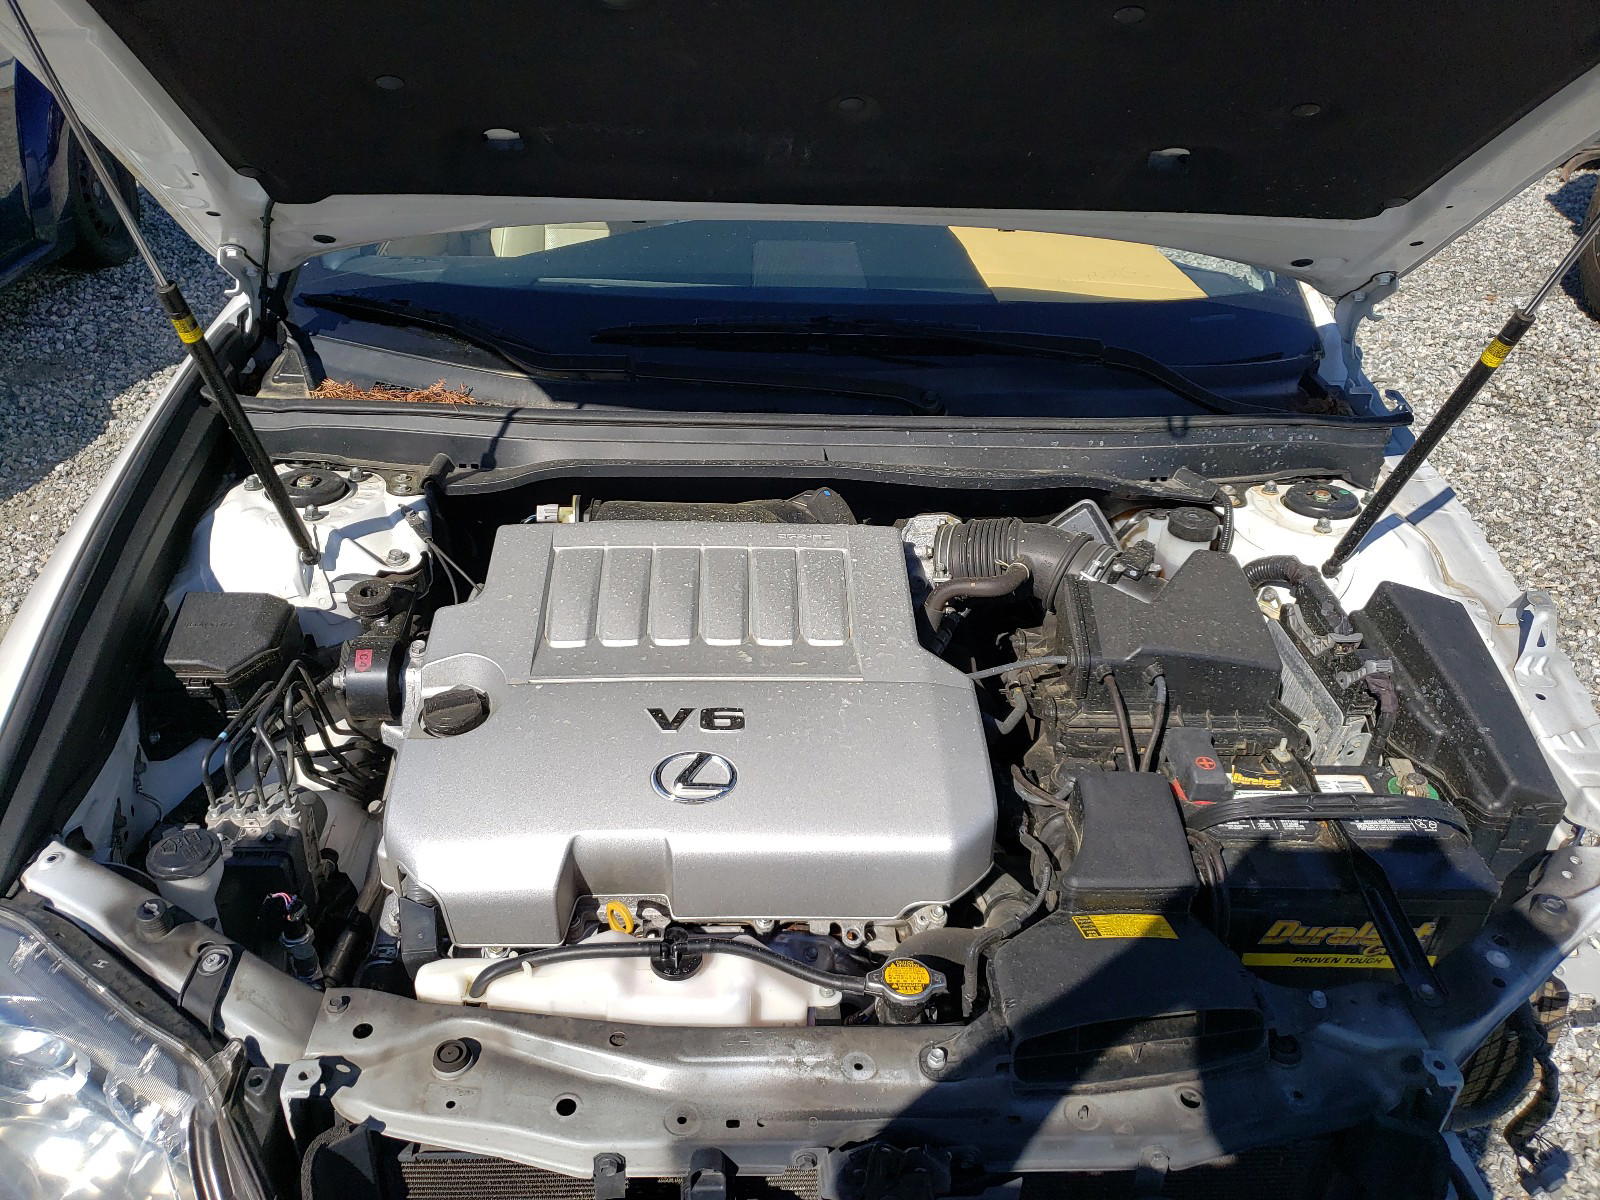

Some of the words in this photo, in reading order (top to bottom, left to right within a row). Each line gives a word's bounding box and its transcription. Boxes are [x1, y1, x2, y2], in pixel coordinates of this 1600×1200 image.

[645, 707, 746, 733] V6
[1258, 919, 1437, 945] Duralt
[1292, 956, 1340, 964] PROVEN
[1344, 956, 1384, 965] TOUGH
